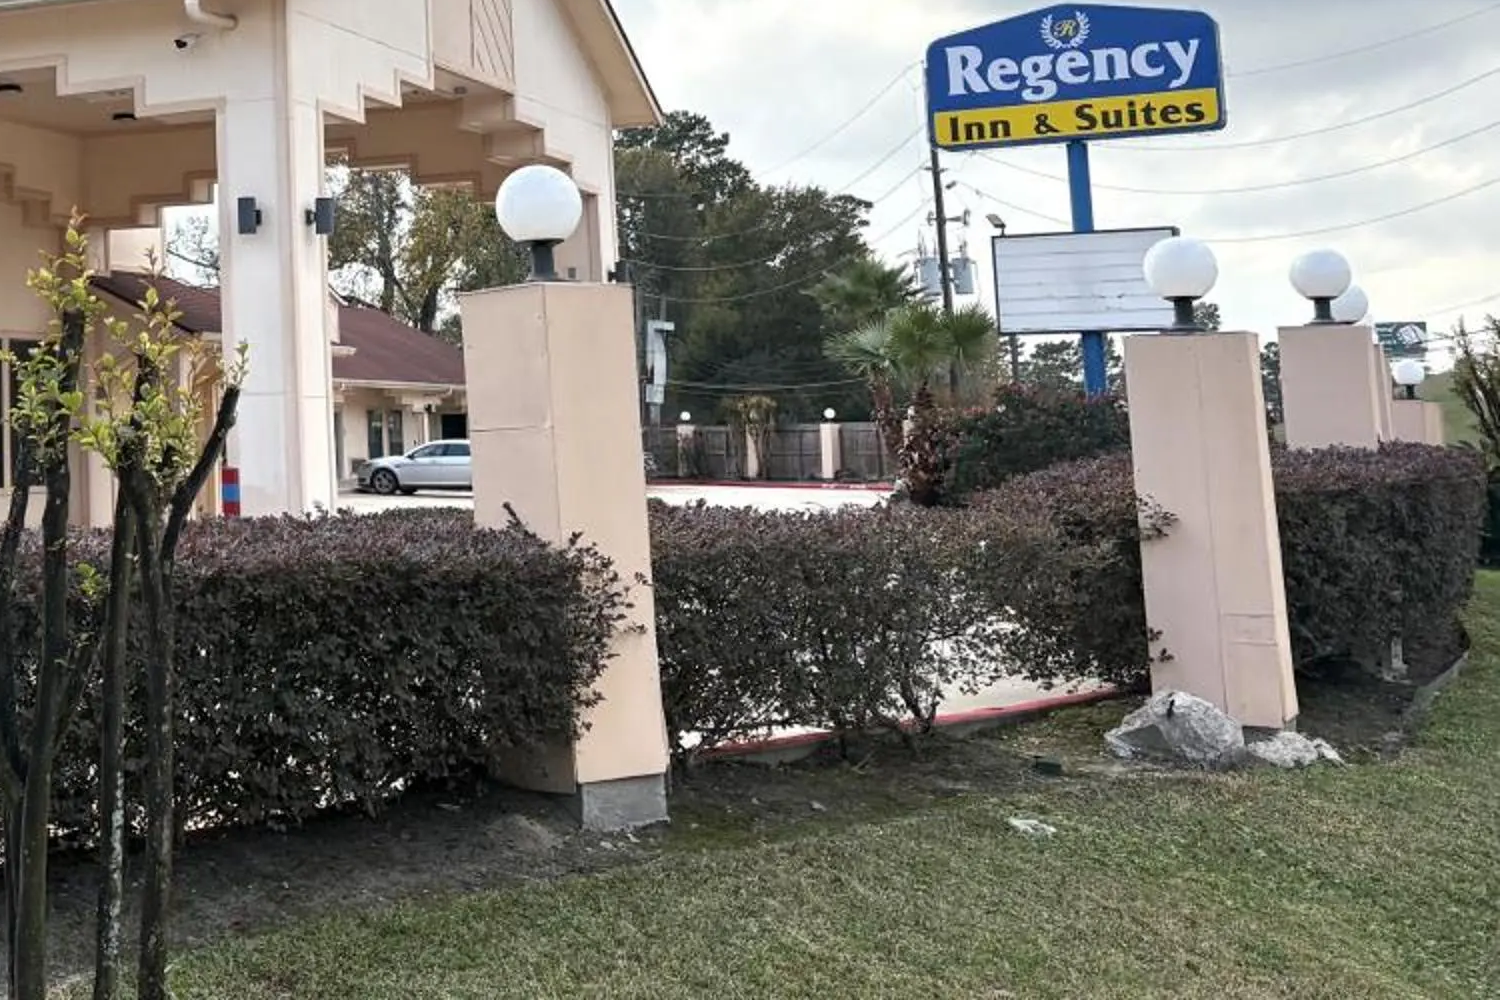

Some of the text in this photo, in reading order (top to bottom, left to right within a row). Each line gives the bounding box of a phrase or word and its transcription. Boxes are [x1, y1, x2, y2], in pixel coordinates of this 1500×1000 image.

[945, 38, 1201, 101] Regency
[950, 100, 1205, 142] Inn & Suites
